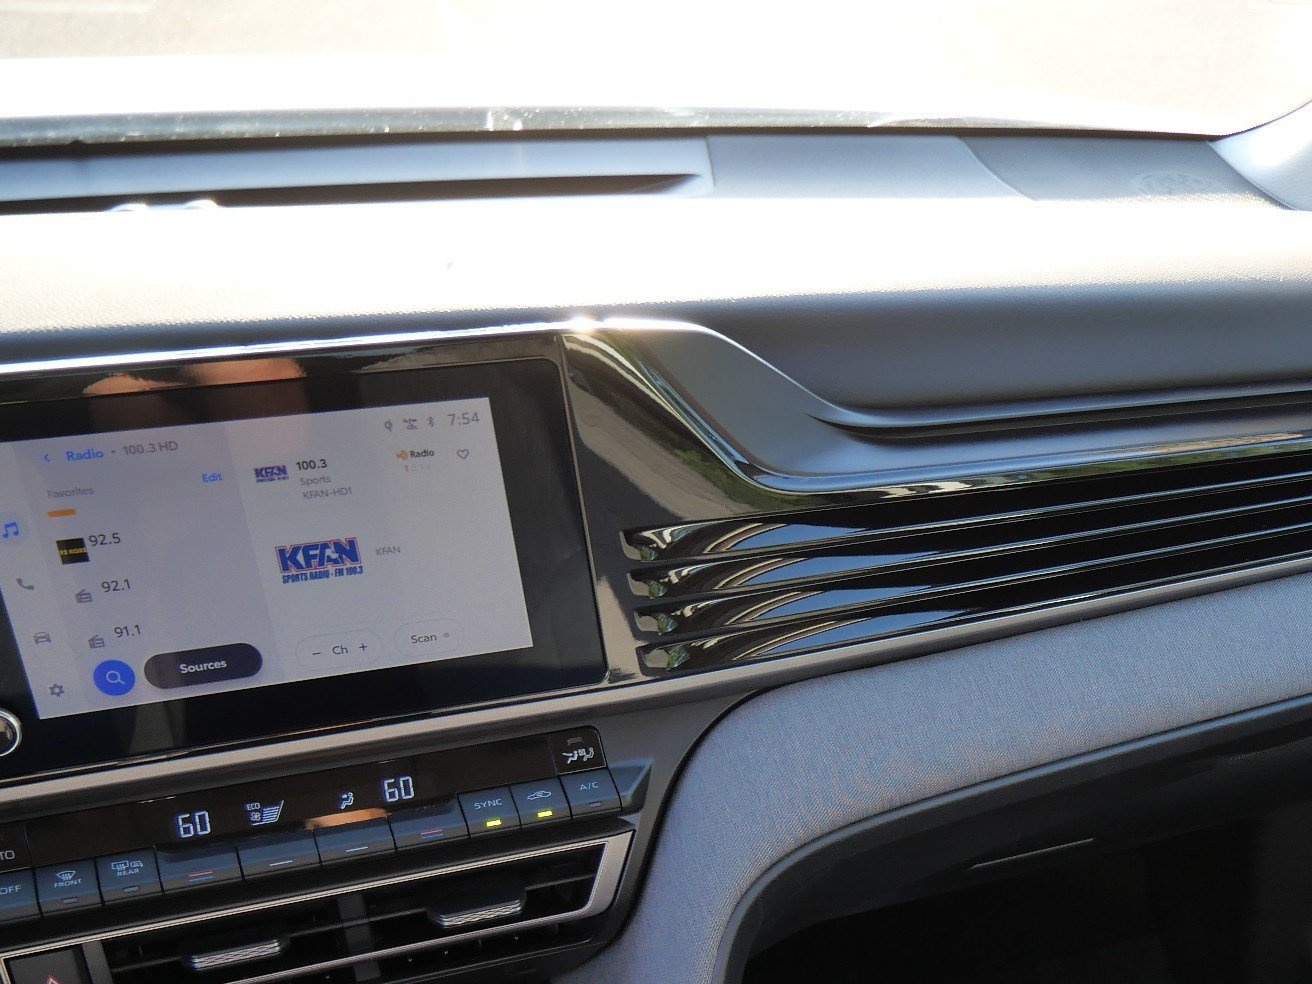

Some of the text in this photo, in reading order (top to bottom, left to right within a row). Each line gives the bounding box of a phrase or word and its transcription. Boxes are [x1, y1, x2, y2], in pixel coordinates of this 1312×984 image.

[448, 412, 480, 427] 7:54
[66, 440, 178, 462] Radio 100.3 HD
[410, 448, 435, 458] Radio
[296, 459, 327, 471] 100.3
[202, 472, 223, 482] Edit
[300, 475, 331, 487] Sports
[47, 486, 95, 498] Favorites
[88, 533, 121, 547] 92.5
[275, 537, 361, 574] KFAN
[375, 546, 400, 556] KFAN
[282, 573, 308, 585] SPORTS
[309, 570, 330, 580] RADIO
[345, 565, 363, 576] 100.3
[102, 579, 131, 592] 92.1
[114, 624, 141, 638] 91.1
[411, 633, 437, 644] Scan
[332, 645, 348, 655] Ch
[180, 659, 227, 673] Sources
[384, 775, 415, 802] 60
[580, 781, 599, 791] A/C
[474, 798, 503, 810] SYNC
[177, 811, 212, 838] 60
[117, 868, 140, 877] REAR
[54, 878, 82, 888] FRONT
